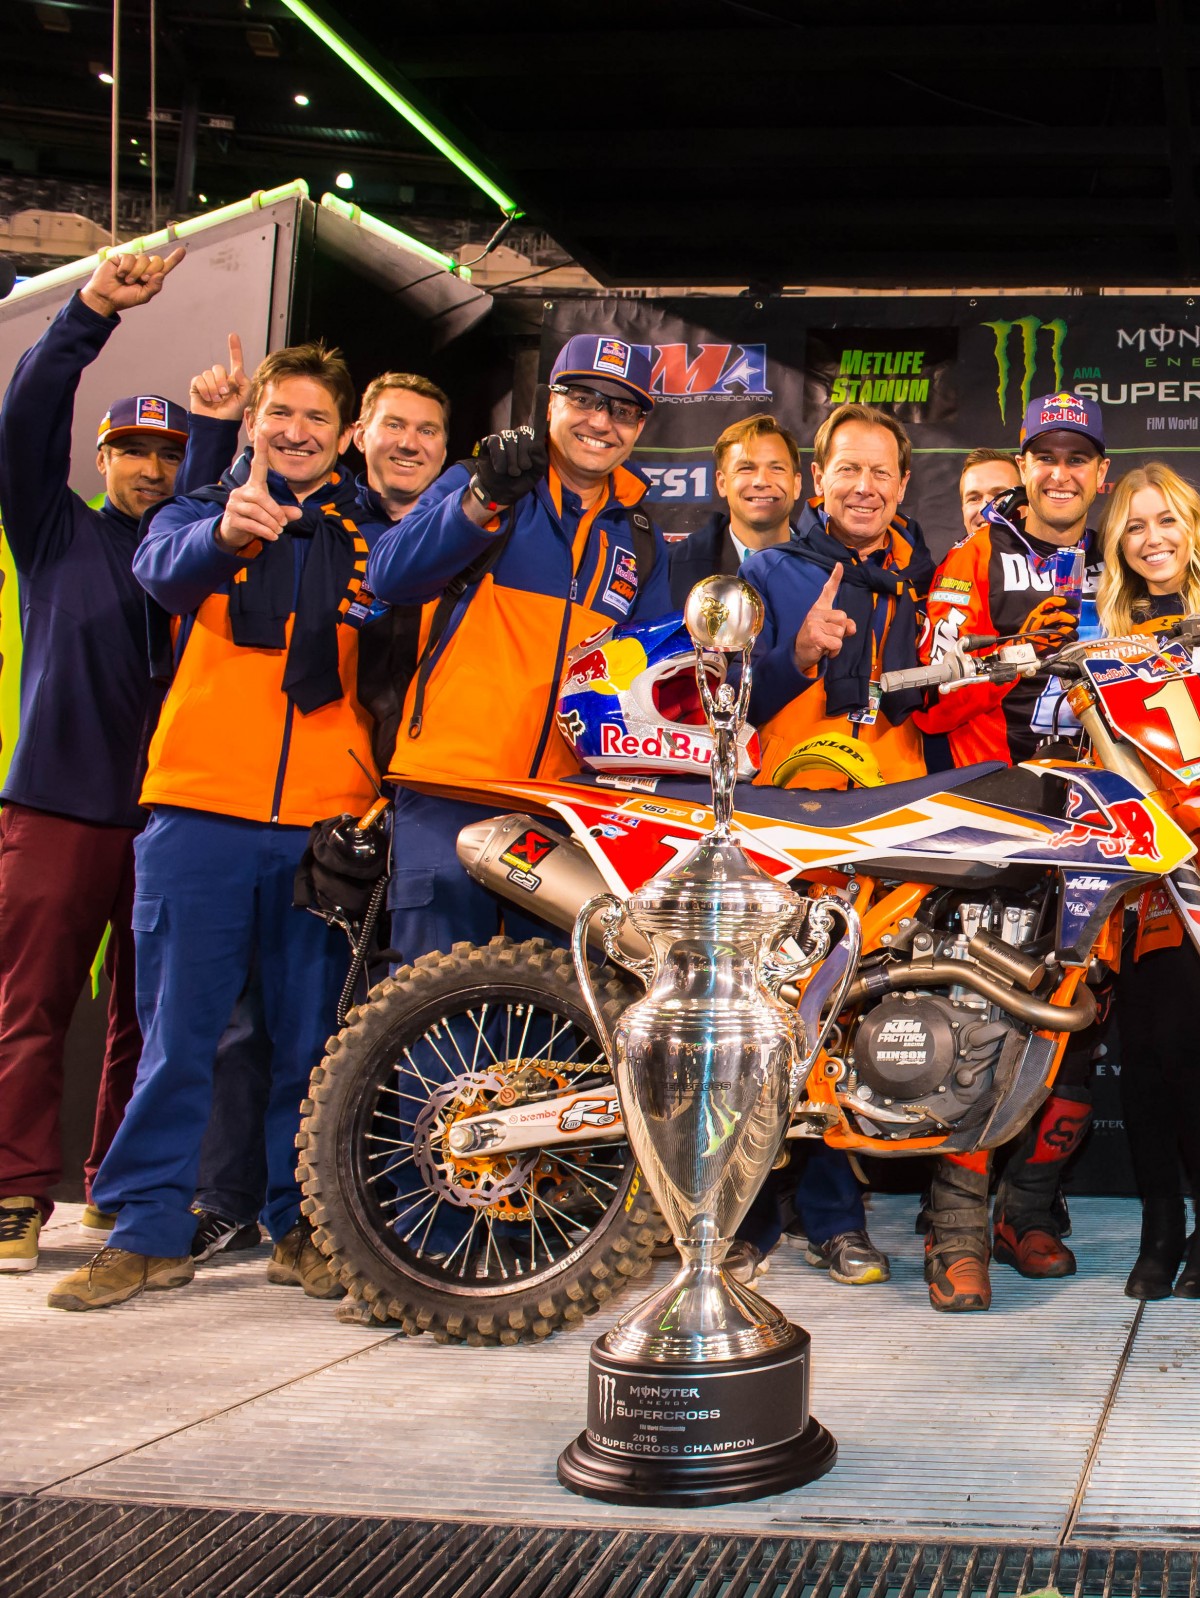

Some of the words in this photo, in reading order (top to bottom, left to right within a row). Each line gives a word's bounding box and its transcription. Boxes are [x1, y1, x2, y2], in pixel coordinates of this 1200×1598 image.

[631, 343, 773, 394] MA
[840, 350, 924, 375] METLIFE
[1073, 368, 1101, 379] AMA
[831, 378, 930, 404] STADIUM
[653, 395, 707, 404] TORCYCLIST
[1041, 408, 1065, 424] Red
[1066, 409, 1089, 426] Bull
[1146, 418, 1165, 430] FIM
[1168, 417, 1198, 430] World
[611, 580, 635, 600] KTM
[1093, 668, 1112, 682] Red
[1112, 665, 1131, 679] Bull
[602, 724, 663, 756] Red
[669, 733, 712, 764] Bu
[793, 739, 865, 763] DUNLOP
[642, 803, 668, 814] 450
[1067, 876, 1108, 890] KTM
[882, 1019, 922, 1033] KTM
[877, 1033, 927, 1042] FACTORY
[877, 1050, 926, 1059] HINSON
[519, 1109, 557, 1123] brembo
[629, 1385, 700, 1398] MONSTER
[617, 1406, 721, 1420] SUPERCROSS
[602, 1436, 679, 1453] SUPERCROSS
[684, 1438, 755, 1454] CHAMPION
[632, 1433, 657, 1443] 2016
